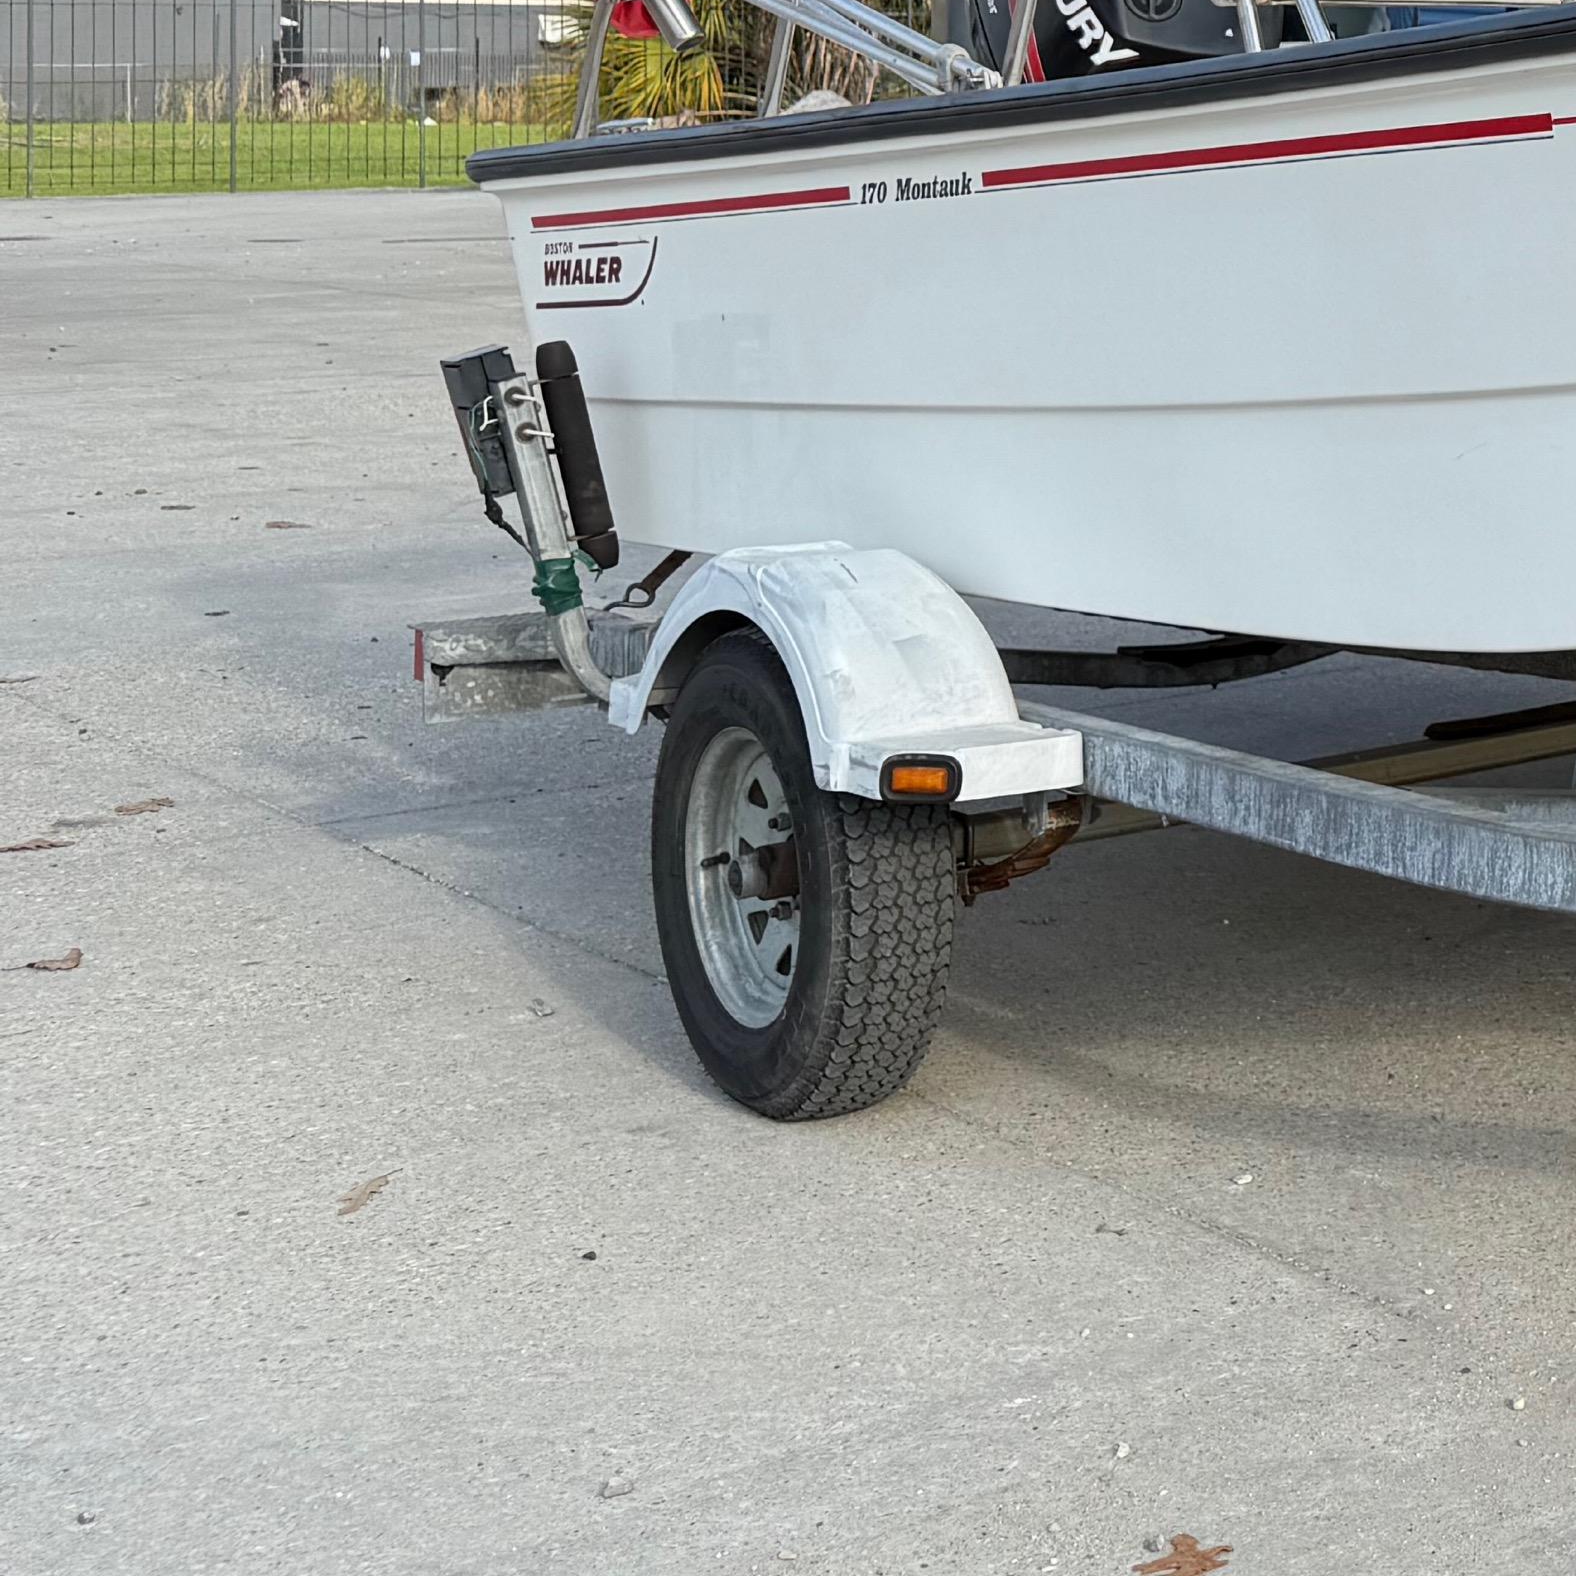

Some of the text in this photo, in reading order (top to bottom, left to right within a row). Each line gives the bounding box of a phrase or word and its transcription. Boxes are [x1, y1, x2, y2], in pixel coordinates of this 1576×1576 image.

[861, 171, 972, 204] 170 Montauk
[543, 256, 622, 287] WHALER
